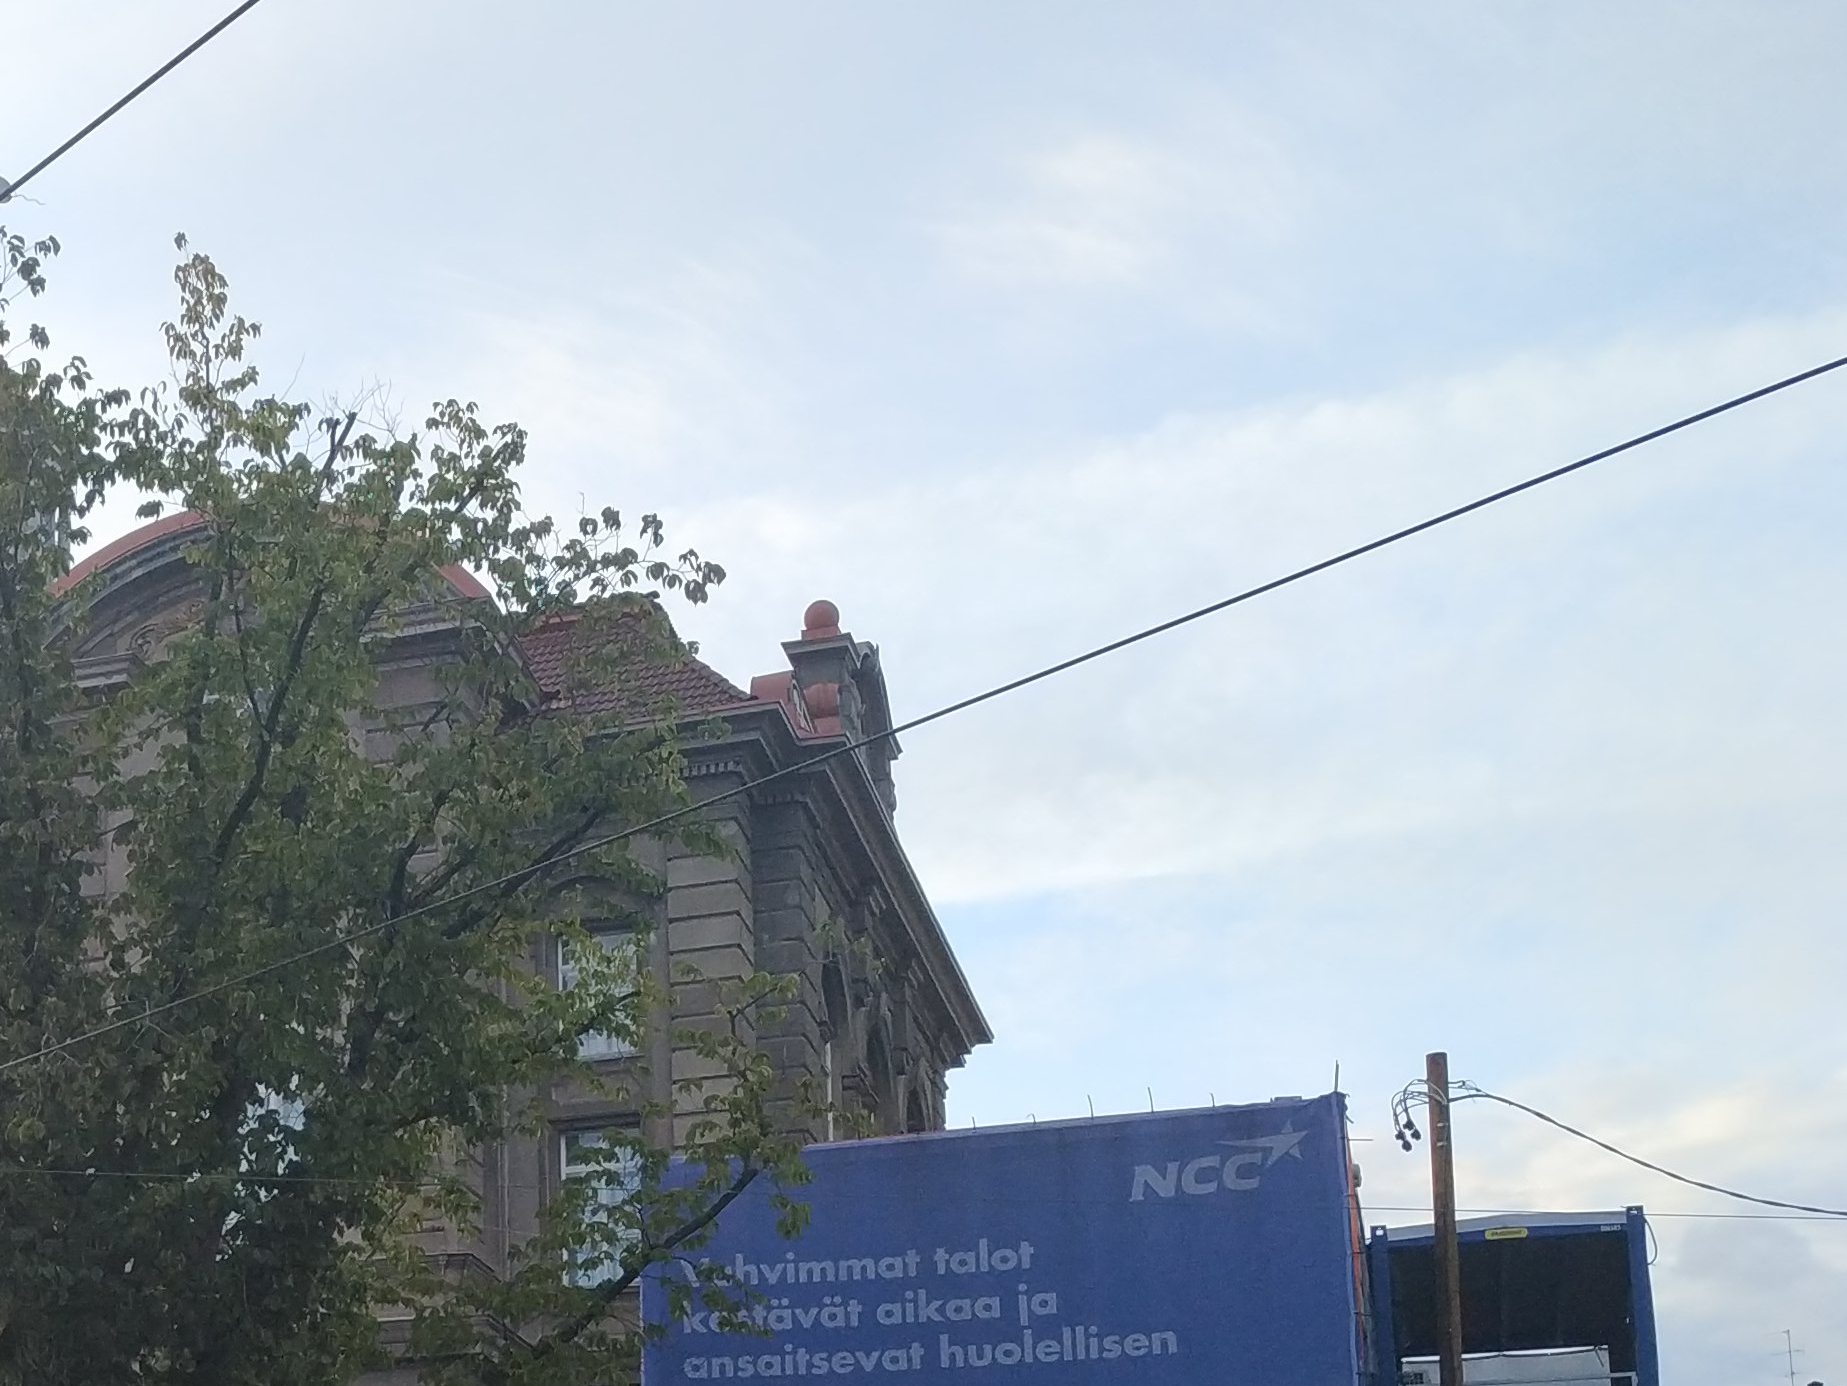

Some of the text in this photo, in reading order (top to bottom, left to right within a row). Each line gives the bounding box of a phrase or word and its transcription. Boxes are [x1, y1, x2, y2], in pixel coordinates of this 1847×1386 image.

[1129, 1152, 1263, 1202] NCC
[934, 1238, 1034, 1275] talot
[876, 1289, 1001, 1326] aikaa
[1018, 1283, 1058, 1326] ja
[683, 1325, 1178, 1379] ansaitsevat huolellisen
